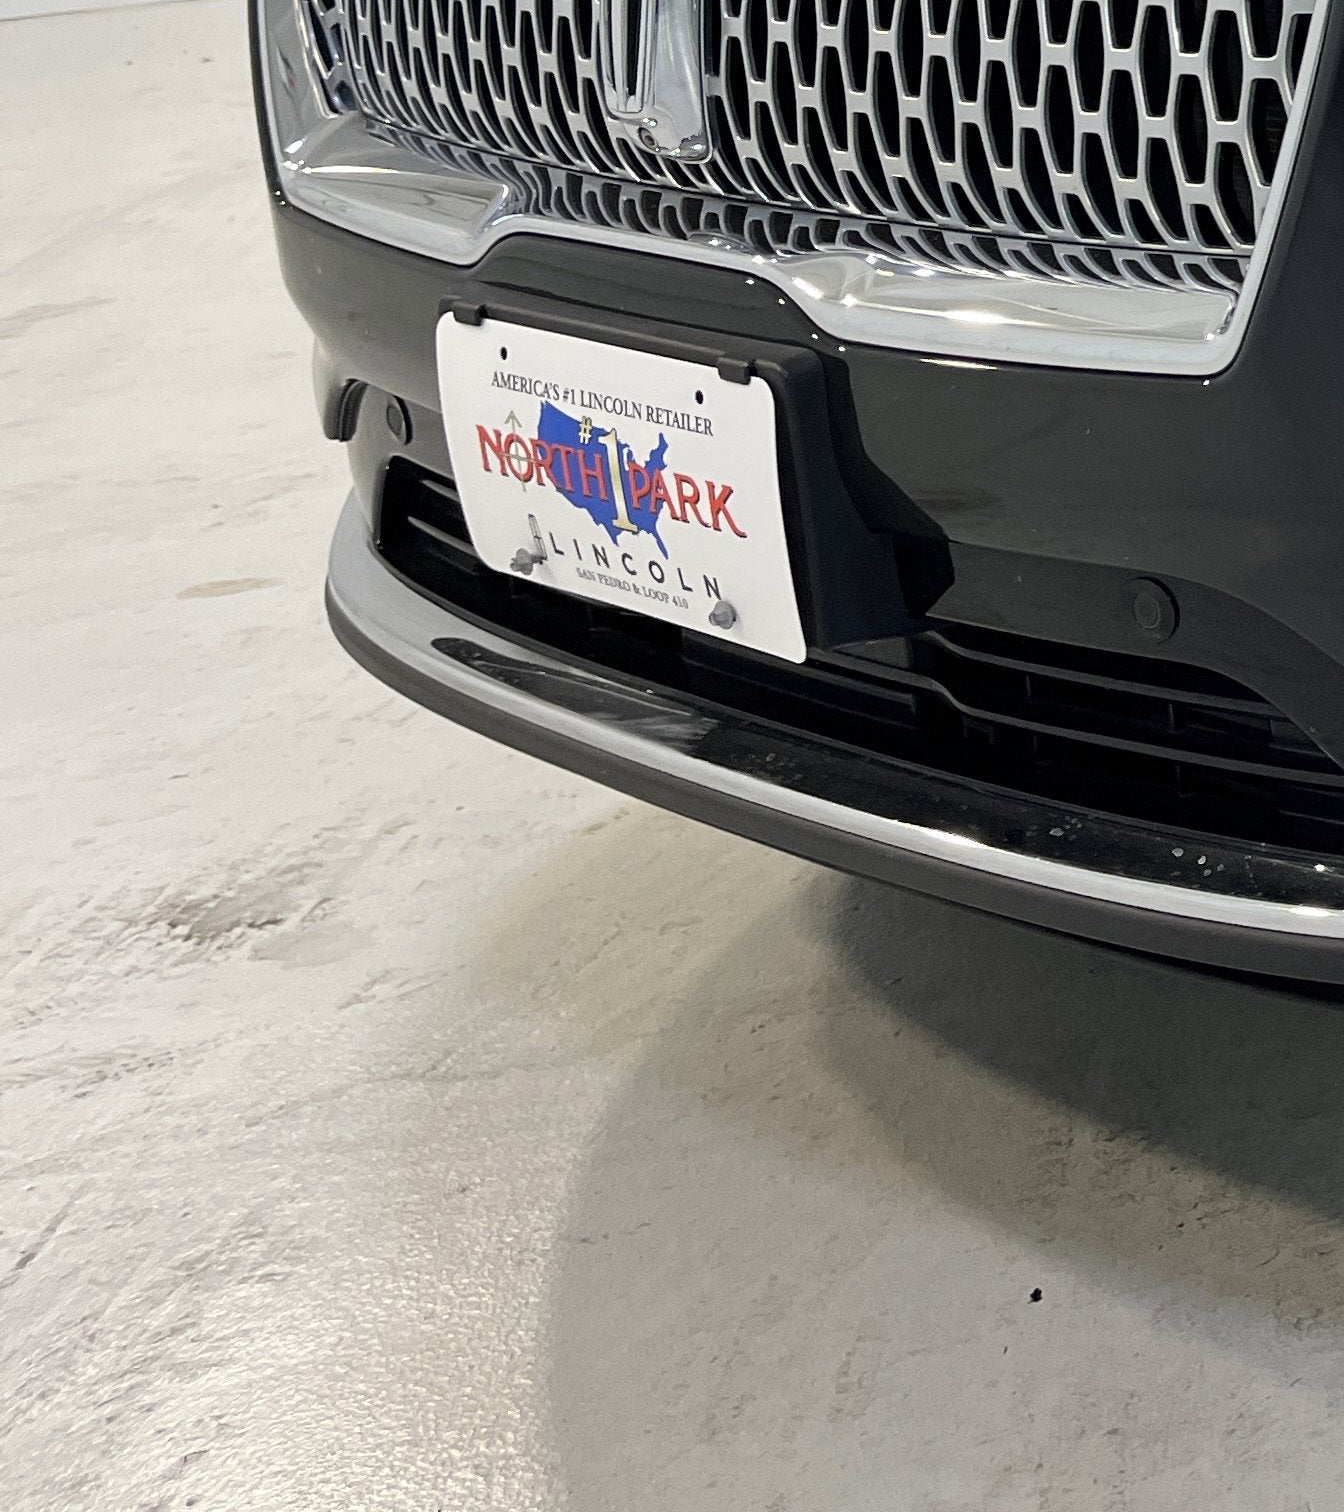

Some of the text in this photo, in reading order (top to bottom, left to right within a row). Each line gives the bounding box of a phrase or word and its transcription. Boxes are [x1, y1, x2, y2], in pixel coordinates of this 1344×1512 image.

[491, 370, 714, 437] AMERICA'S #1 LINCOLN RETAILER
[475, 424, 748, 539] NORTH PARK
[549, 531, 722, 601] LINCOLN
